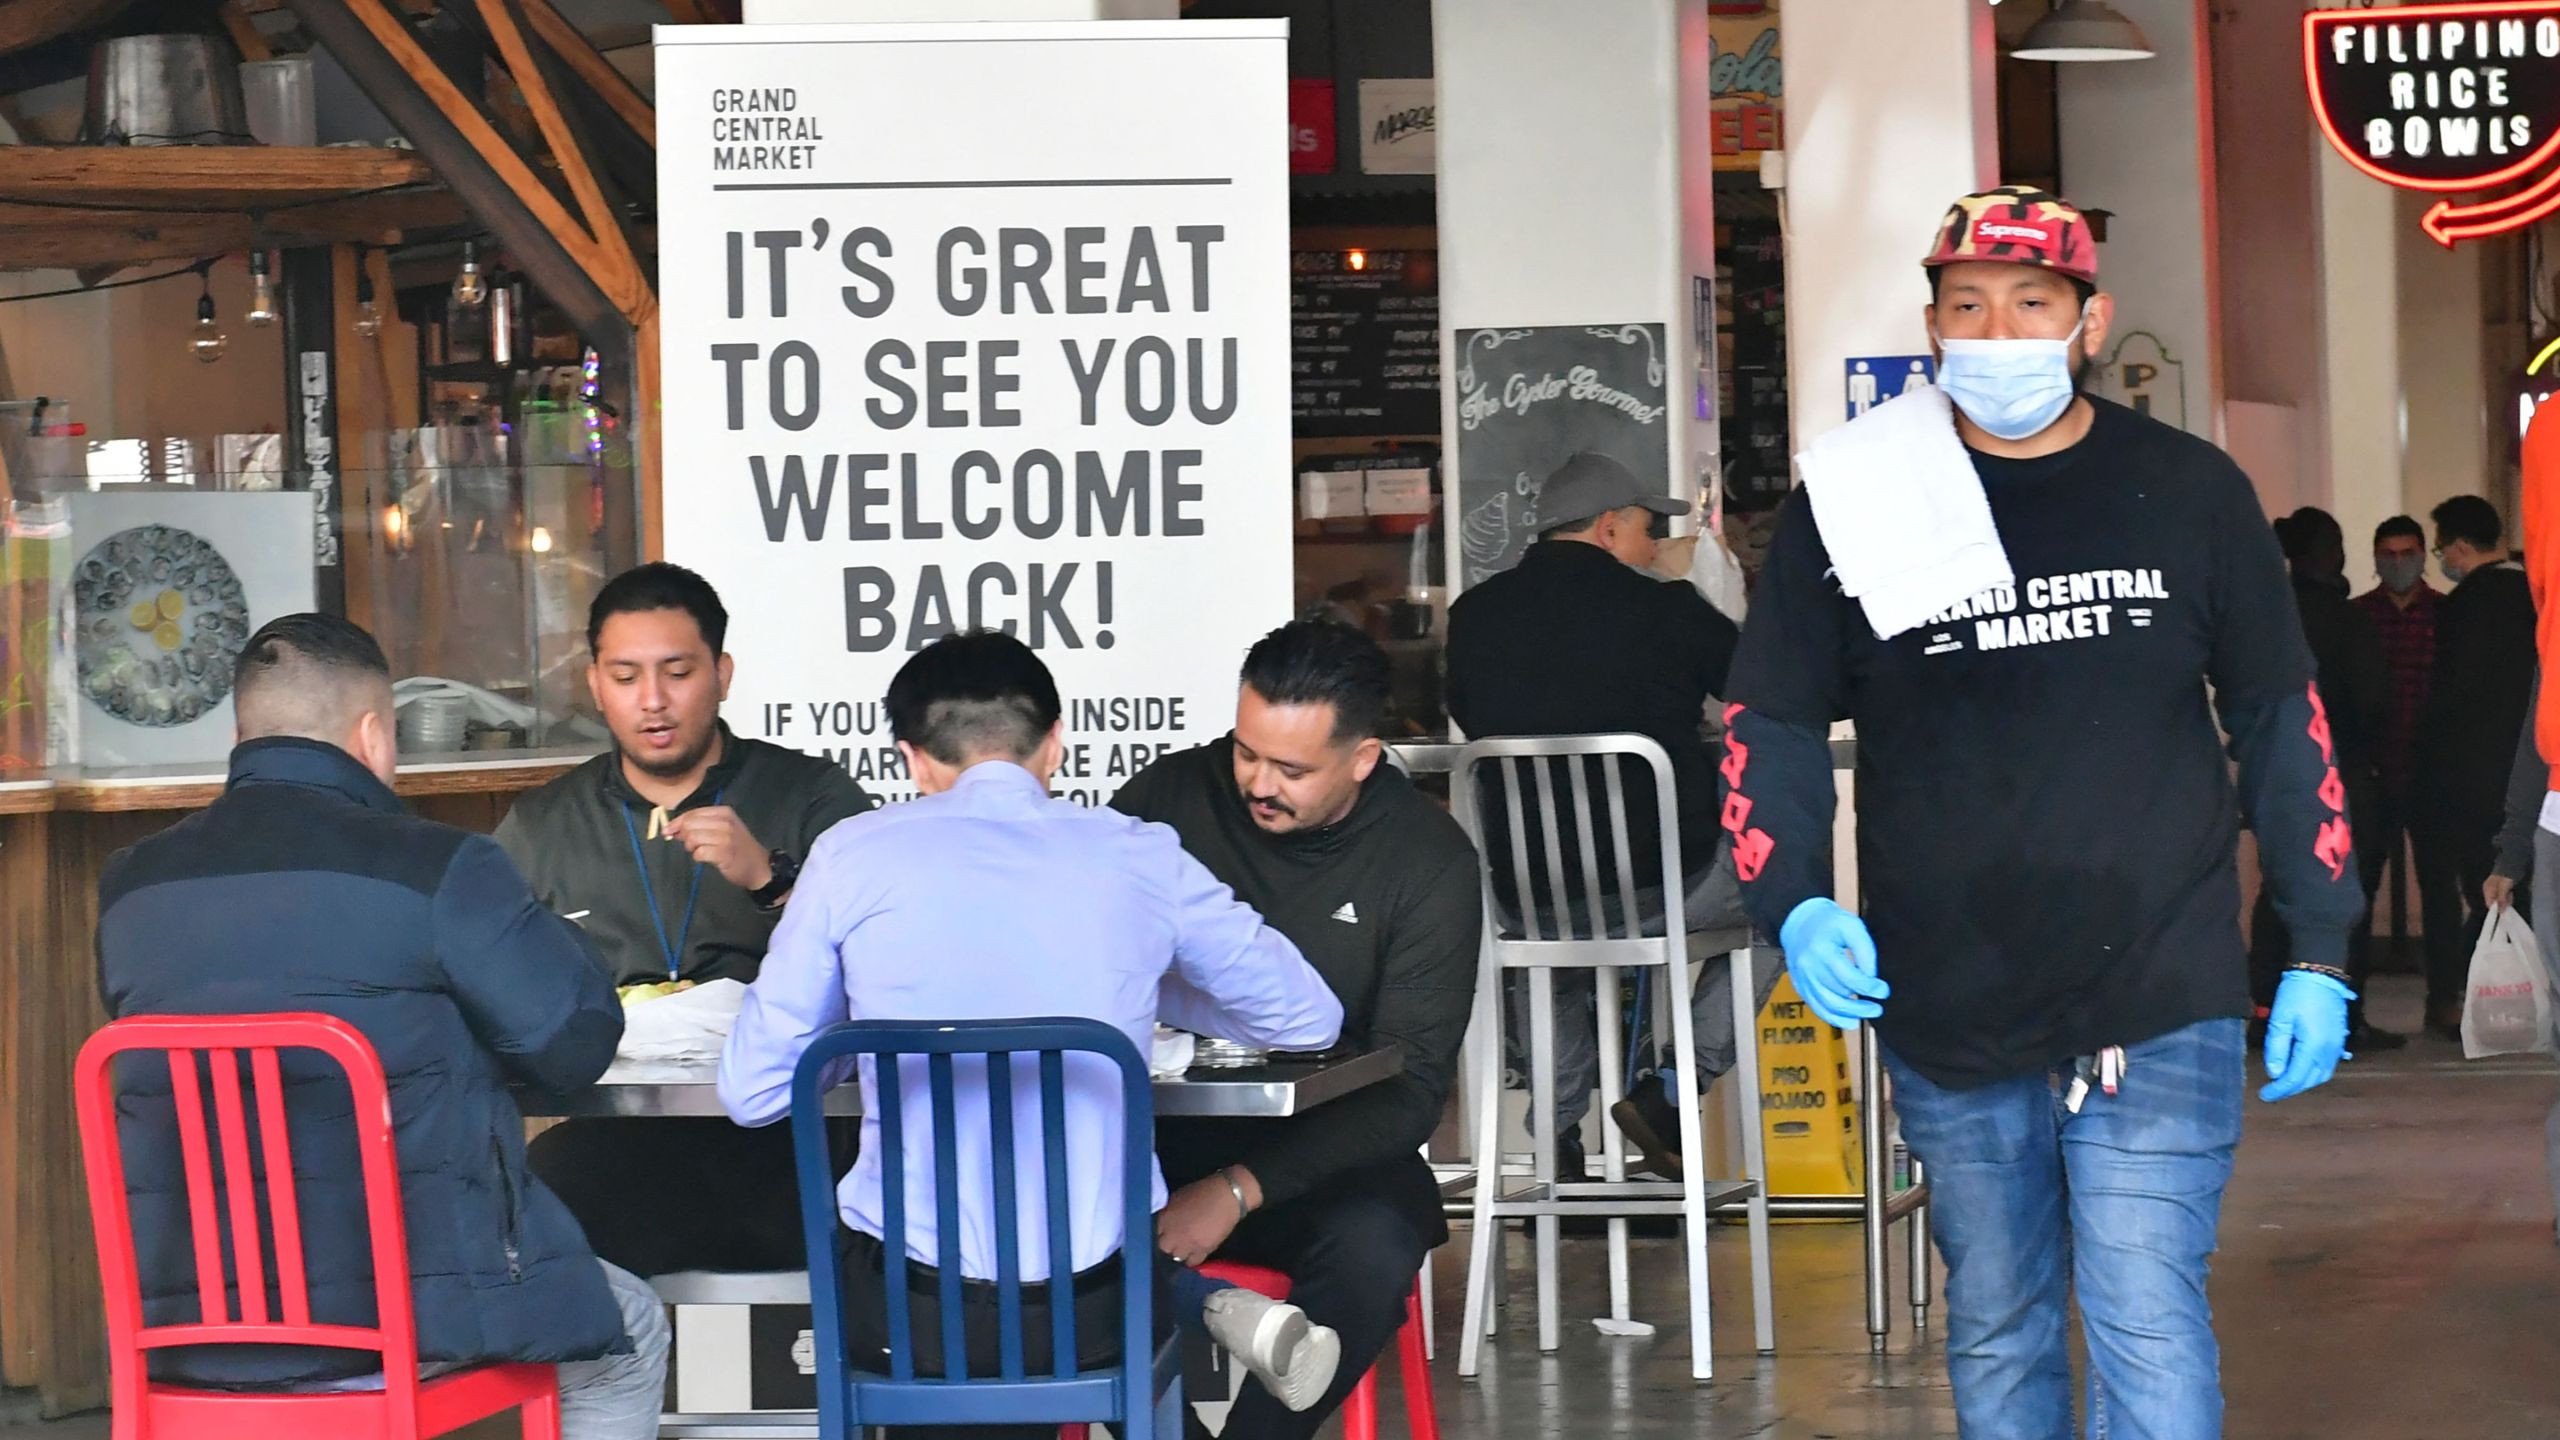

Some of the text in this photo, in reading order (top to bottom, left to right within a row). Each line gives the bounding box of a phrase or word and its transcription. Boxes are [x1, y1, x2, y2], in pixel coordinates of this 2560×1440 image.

[1708, 28, 1783, 97] ola
[2332, 18, 2560, 64] FILIPINO
[713, 88, 796, 113] GRAND
[2390, 67, 2509, 110] RICE
[713, 117, 823, 142] CENTRAL
[1710, 105, 1784, 156] EE
[2366, 115, 2530, 156] BOWLS
[714, 145, 816, 170] MARKET
[1978, 222, 2048, 240] Supreme
[726, 217, 1225, 318] IT'S GREAT
[711, 335, 1238, 431] TO SEE YOU
[1460, 382, 1500, 430] The
[1568, 365, 1664, 424] Gourmet
[748, 448, 1204, 543] WELCOME
[843, 560, 1116, 653] BACK!
[1928, 568, 2169, 624] RAND CENTRAL
[1974, 604, 2112, 650] MARKET
[764, 696, 1186, 737] IF YOU INSIDE
[1771, 1001, 1806, 1019] WET
[1763, 1026, 1817, 1044] FLOOR
[1772, 1066, 1810, 1085] PISO
